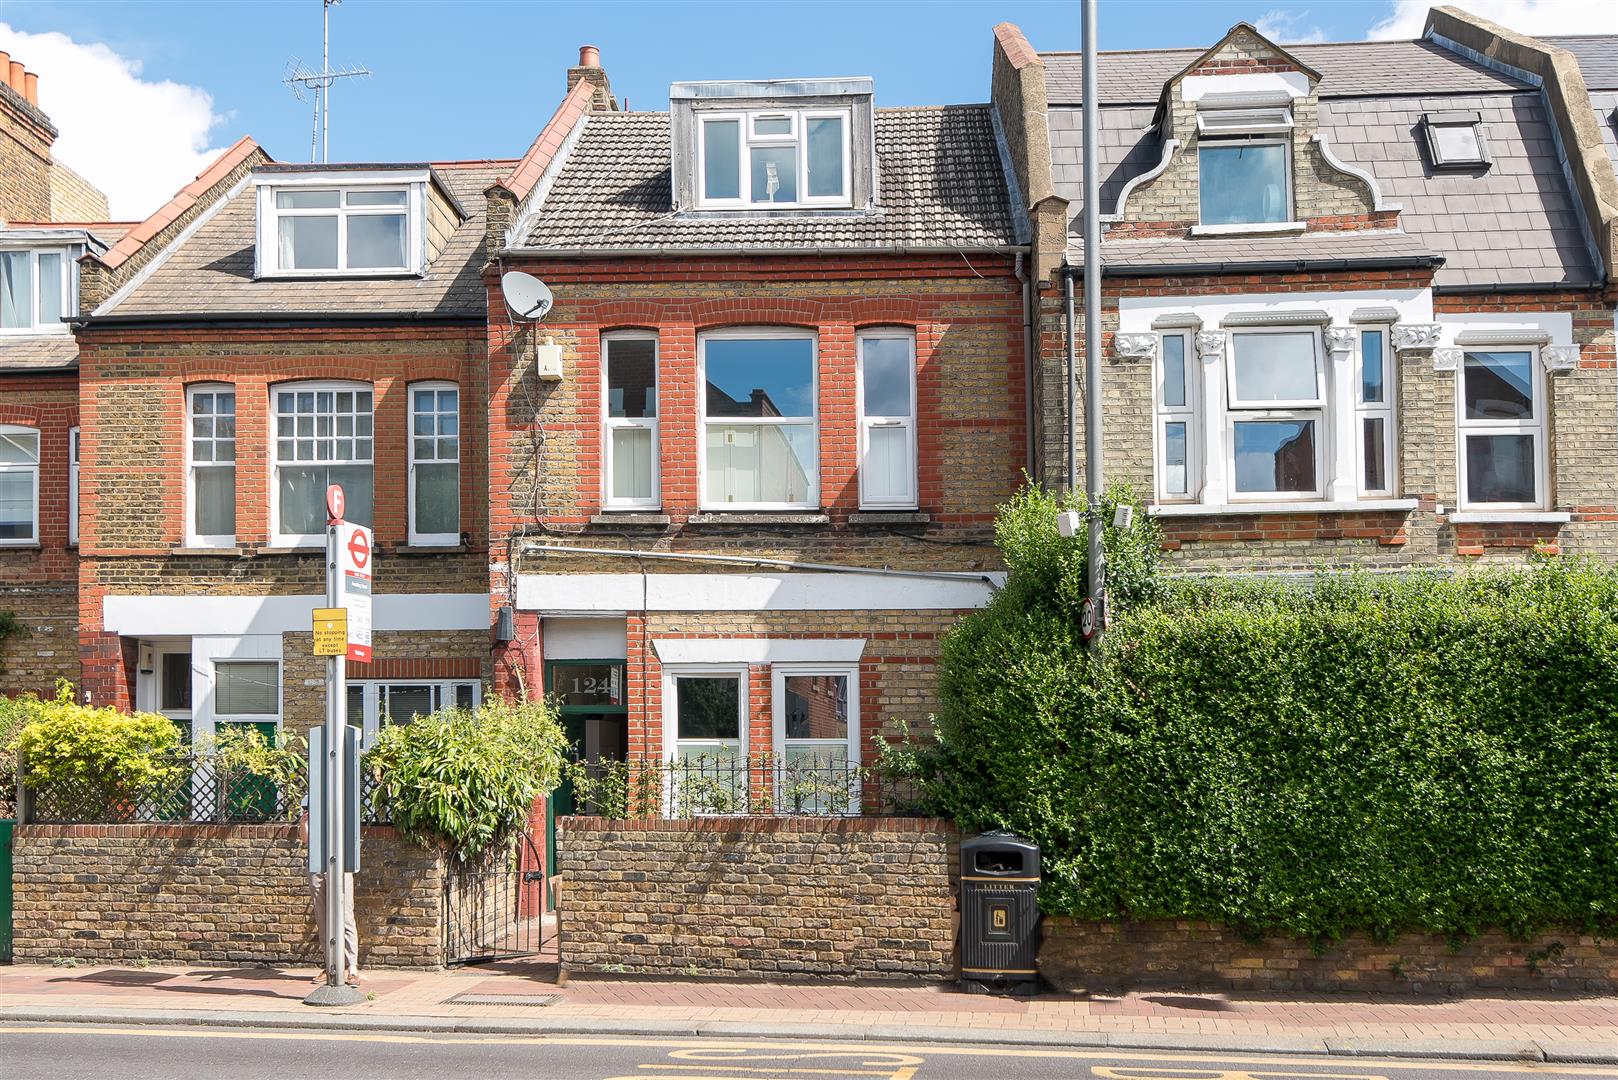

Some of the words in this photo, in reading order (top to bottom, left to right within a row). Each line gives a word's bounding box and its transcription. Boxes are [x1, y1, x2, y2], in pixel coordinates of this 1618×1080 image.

[333, 490, 342, 514] F
[1082, 610, 1092, 627] 20
[570, 677, 611, 694] 124
